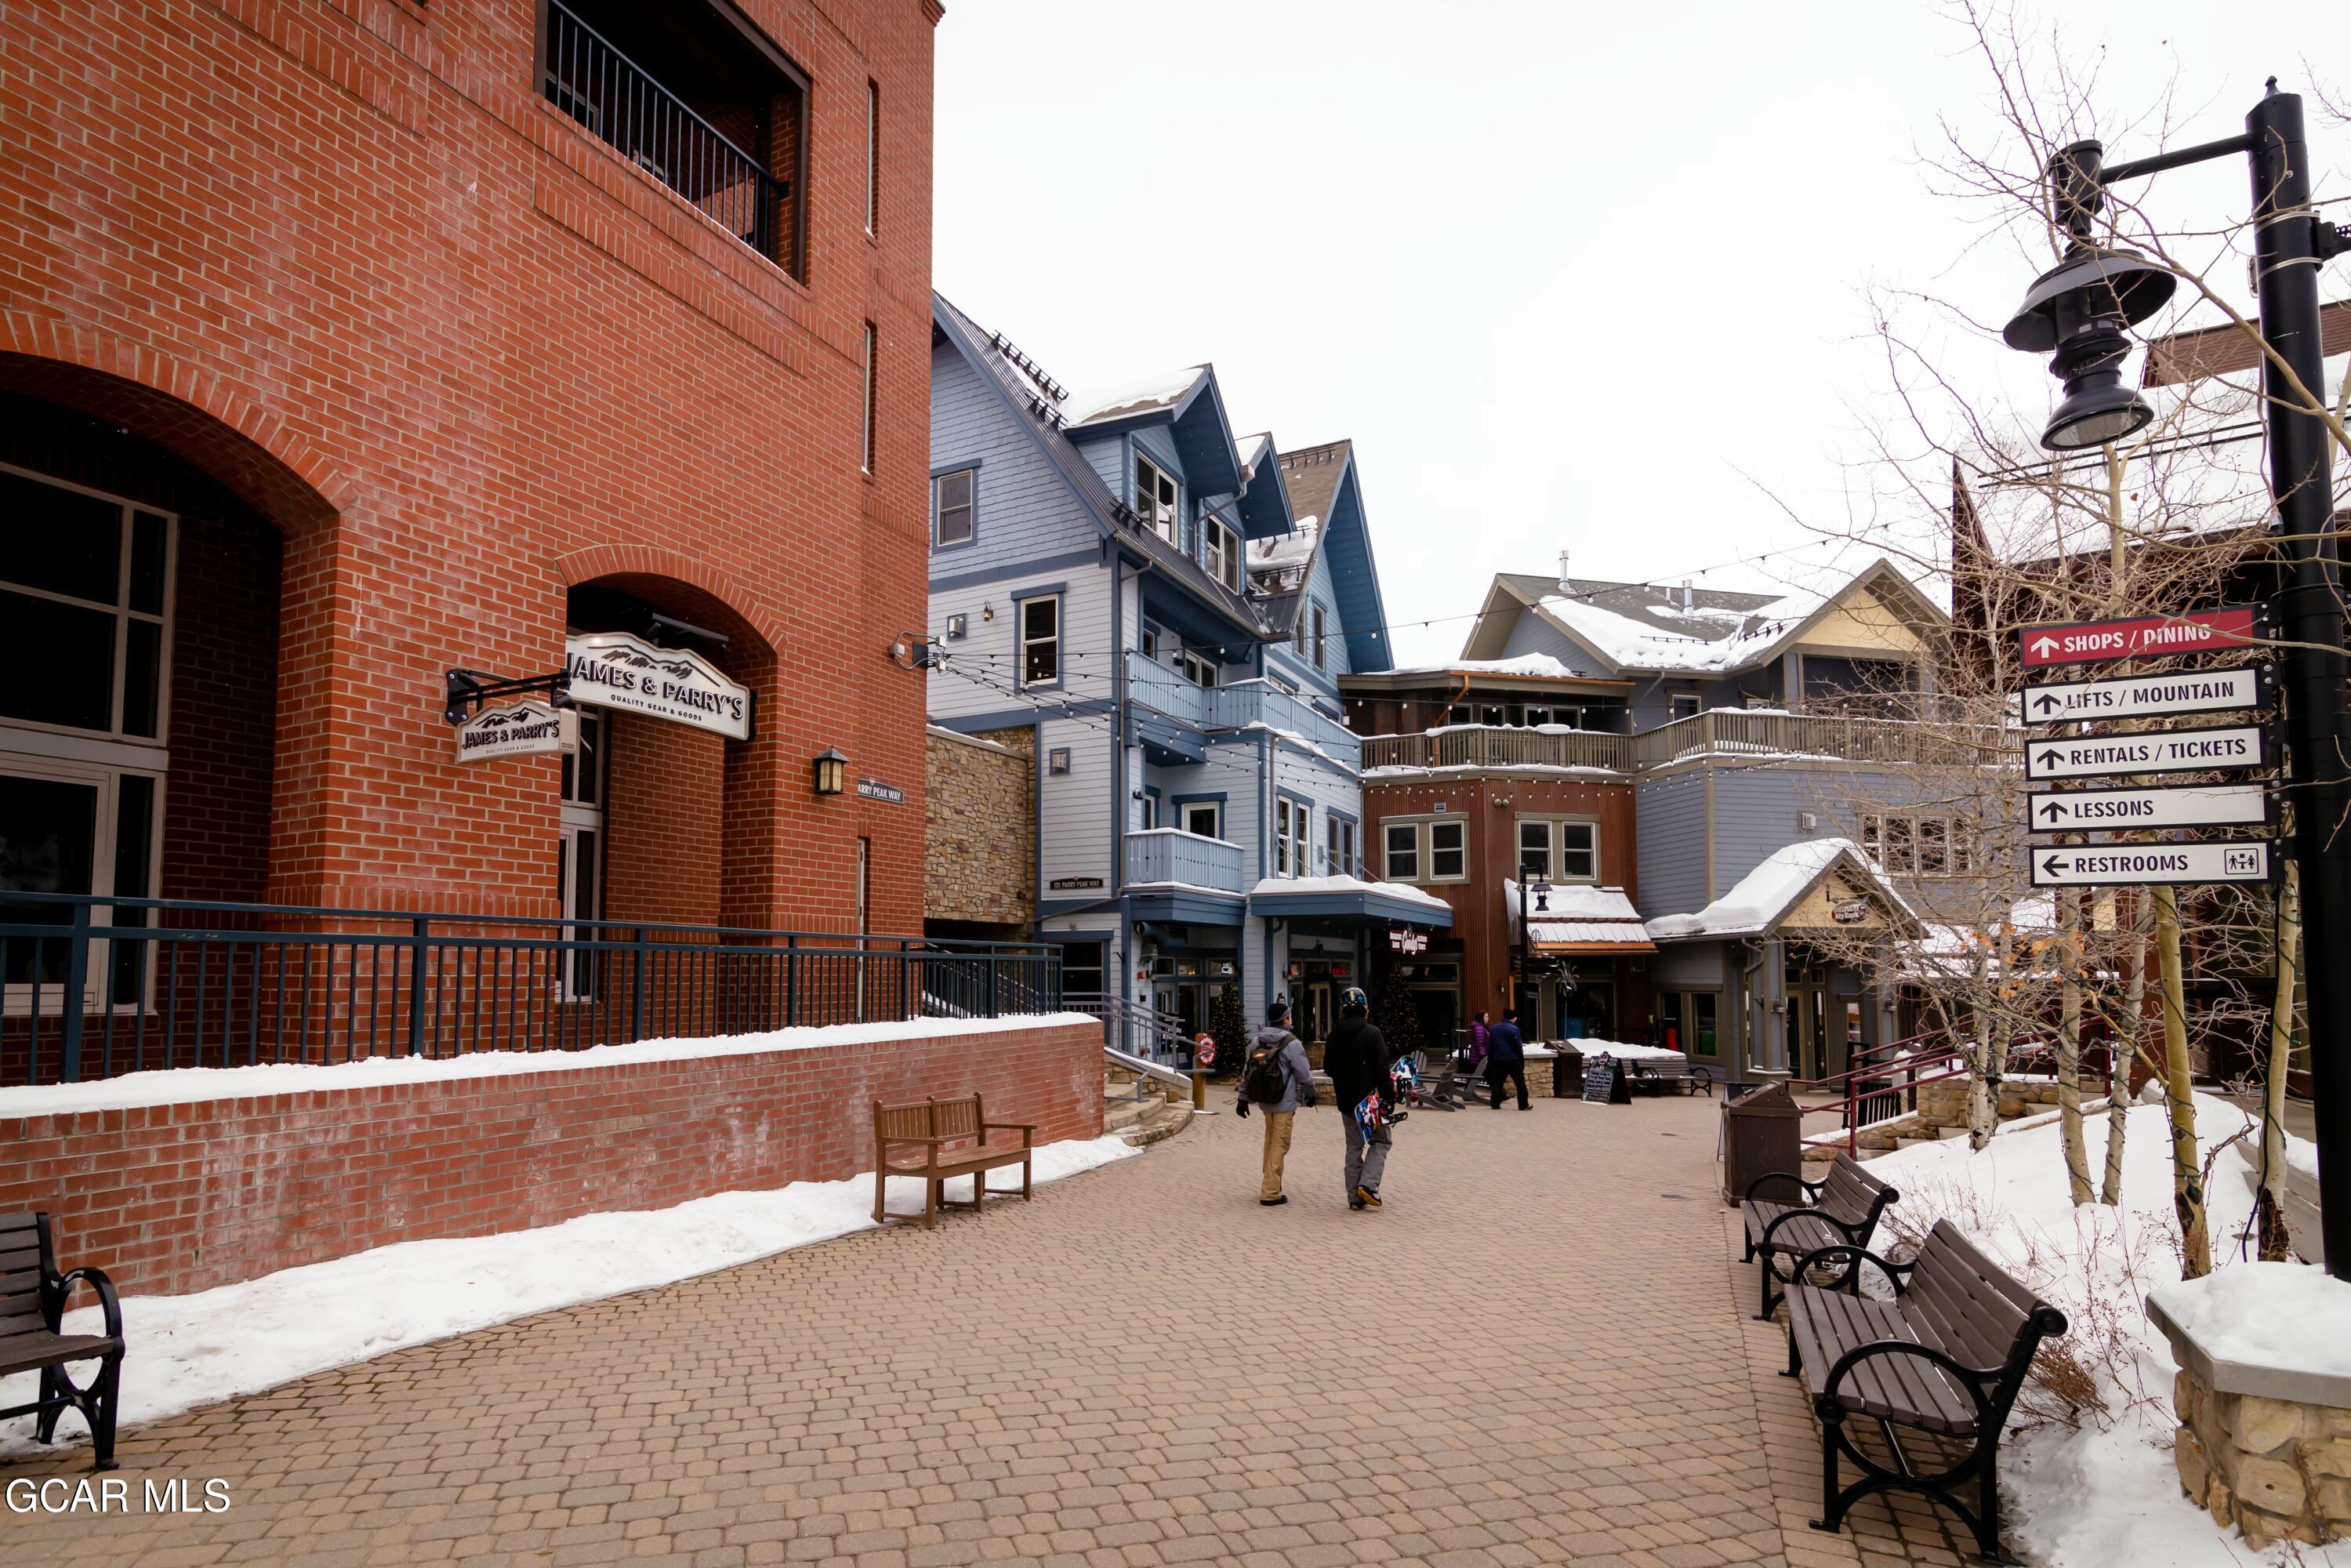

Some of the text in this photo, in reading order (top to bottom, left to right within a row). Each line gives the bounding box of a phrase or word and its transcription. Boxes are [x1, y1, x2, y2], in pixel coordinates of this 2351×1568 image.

[2064, 623, 2211, 653] SHOPS / DINING
[567, 652, 743, 720] JAMES & PARRY'S
[2067, 681, 2234, 709] LIFTS / MOUNTAIN
[611, 694, 644, 707] QUALITY
[648, 703, 667, 713] GEAR
[678, 710, 702, 720] GOODS
[462, 720, 559, 749] JAMES & PARRY'S
[2070, 739, 2247, 765] RENTALS / TICKETS
[858, 784, 901, 800] ARRY PEAK WAY
[2074, 800, 2154, 818] LESSONS
[2075, 855, 2189, 873] RESTROOMS
